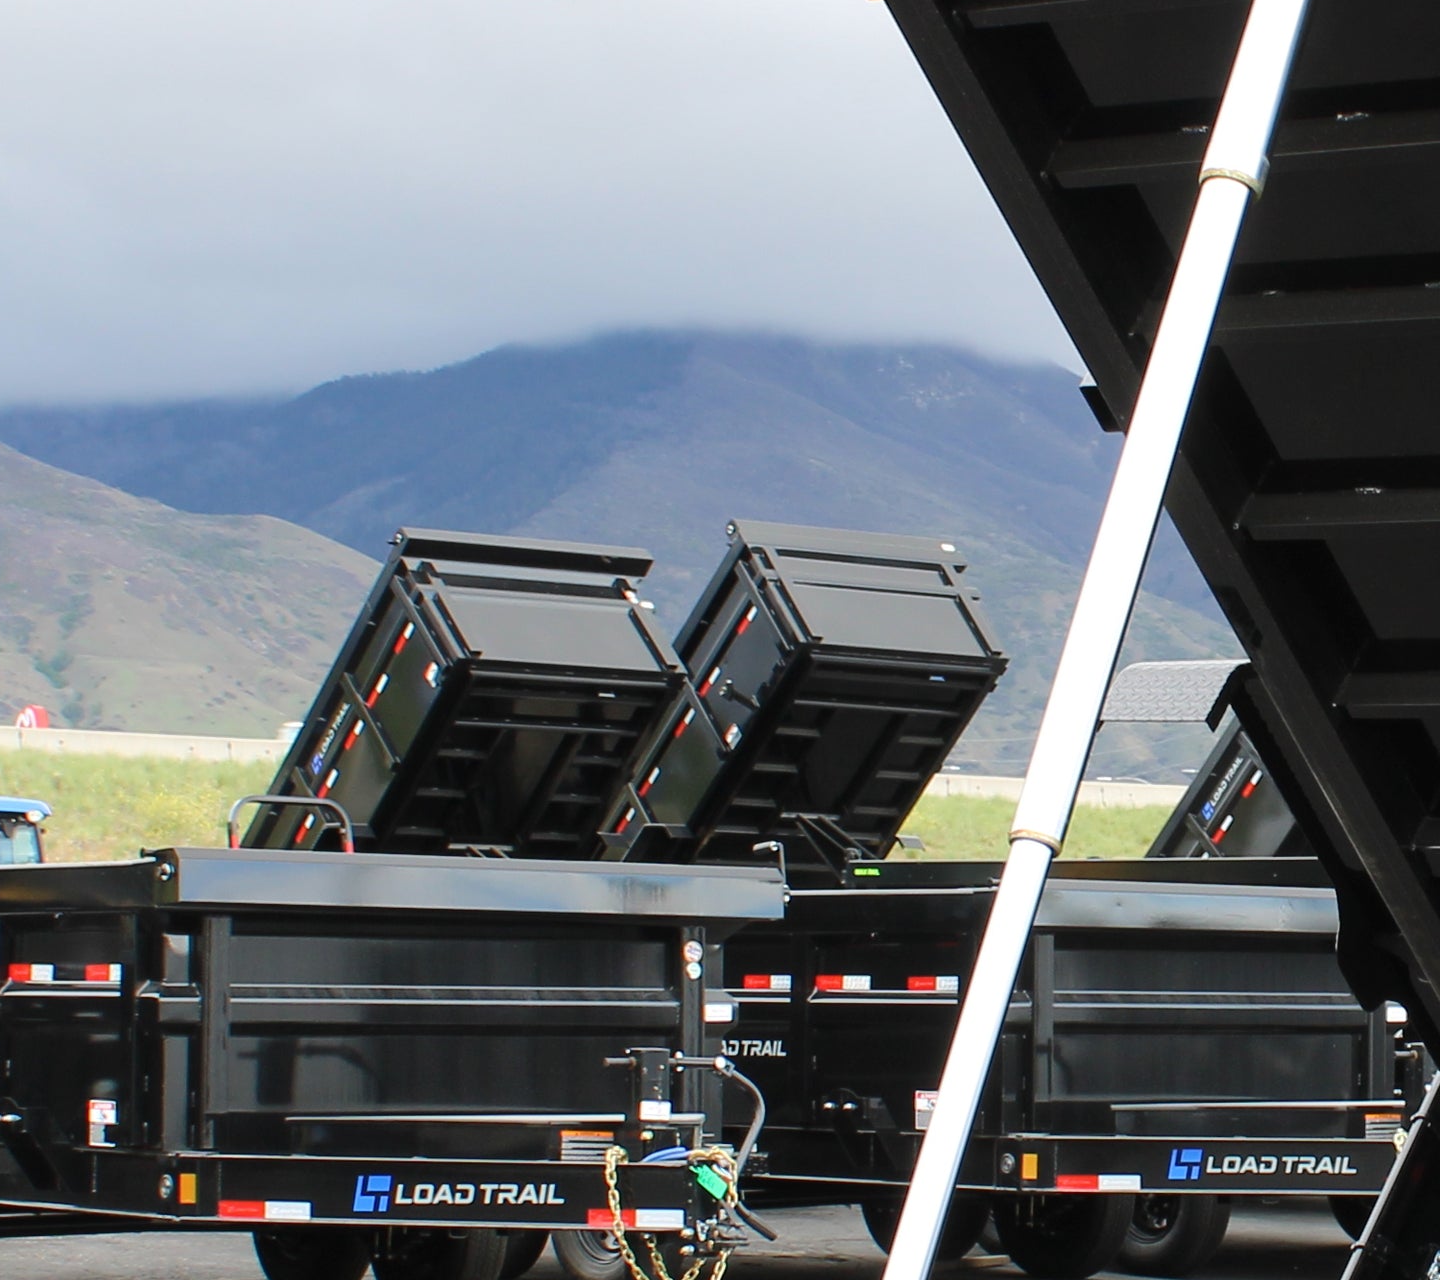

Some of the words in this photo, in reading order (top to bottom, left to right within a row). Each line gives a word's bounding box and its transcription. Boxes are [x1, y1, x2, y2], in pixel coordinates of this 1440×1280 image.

[1210, 779, 1229, 807] LOAD
[1225, 757, 1244, 782] TRAIL
[741, 1040, 787, 1057] TRAIL
[1206, 1155, 1278, 1174] LOAD
[1281, 1156, 1357, 1175] TRAIL
[394, 1183, 476, 1205] LOAD
[479, 1183, 565, 1205] TRAIL
